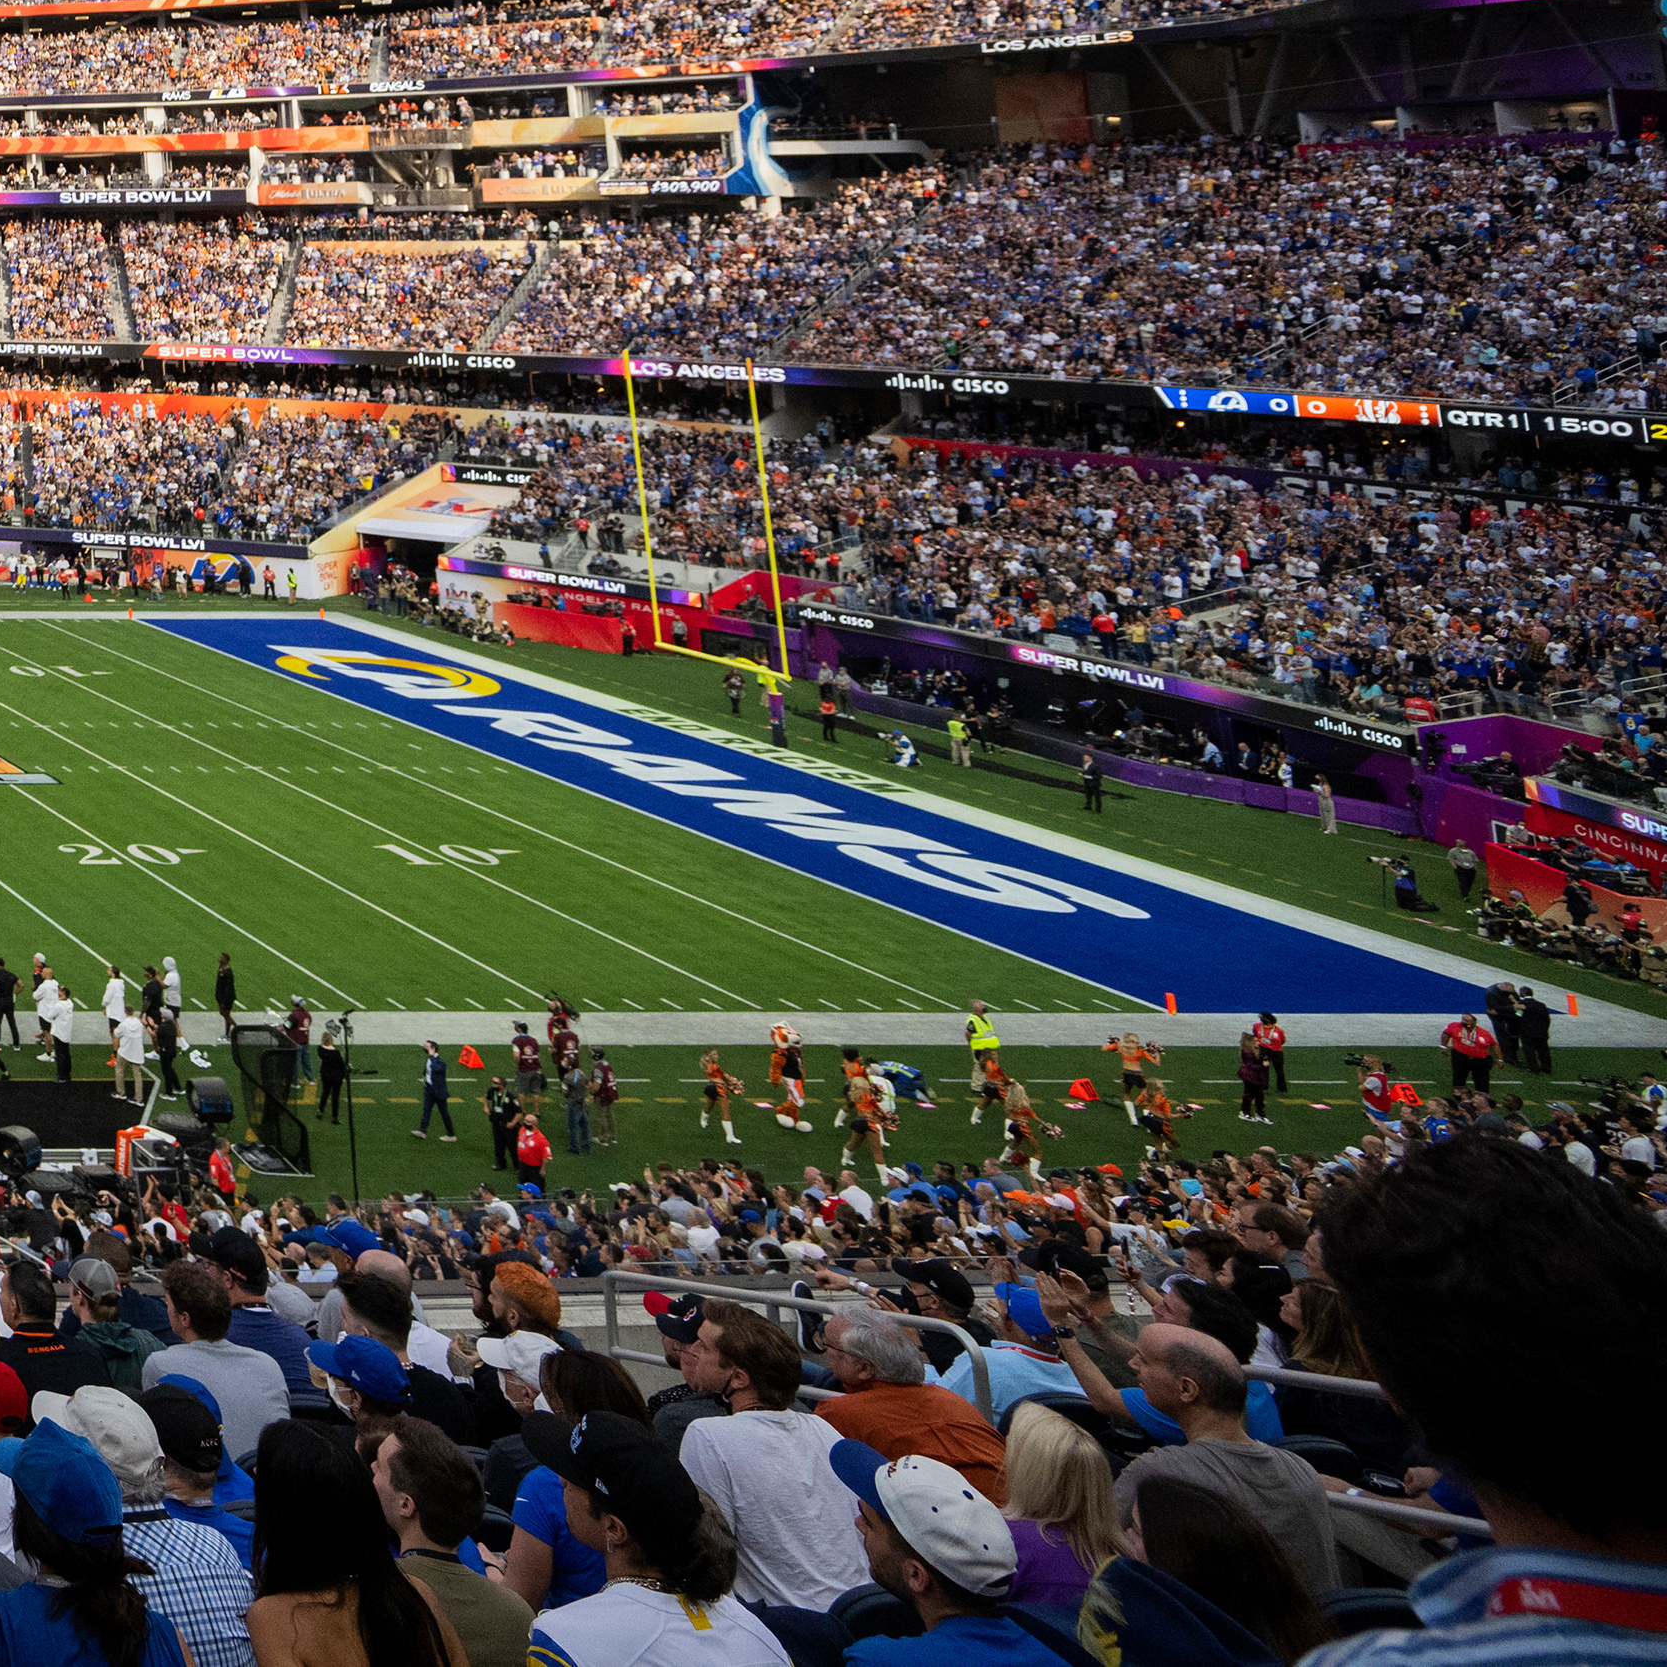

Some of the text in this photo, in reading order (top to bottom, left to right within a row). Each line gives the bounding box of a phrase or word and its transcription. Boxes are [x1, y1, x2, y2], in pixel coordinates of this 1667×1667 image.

[980, 30, 1134, 53] LOS ANGELES
[369, 80, 426, 92] BENGALS
[59, 190, 211, 204] SUPER BOWL LVI
[37, 344, 82, 355] BOWL
[82, 345, 103, 356] LVI
[158, 345, 294, 361] SUPER BOWL
[466, 355, 516, 369] CISCO
[628, 361, 787, 383] LOS ANGELES
[951, 378, 1010, 395] CISCO
[1544, 415, 1633, 437] 15:00
[72, 532, 181, 549] SUPER BOWL
[507, 565, 599, 591] SUPER BOWL
[839, 613, 873, 629] CISCO
[1018, 646, 1136, 686] SUPER BOWL
[1362, 727, 1402, 749] CISCO
[615, 708, 913, 793] END RACISM
[469, 705, 1151, 922] RAMS
